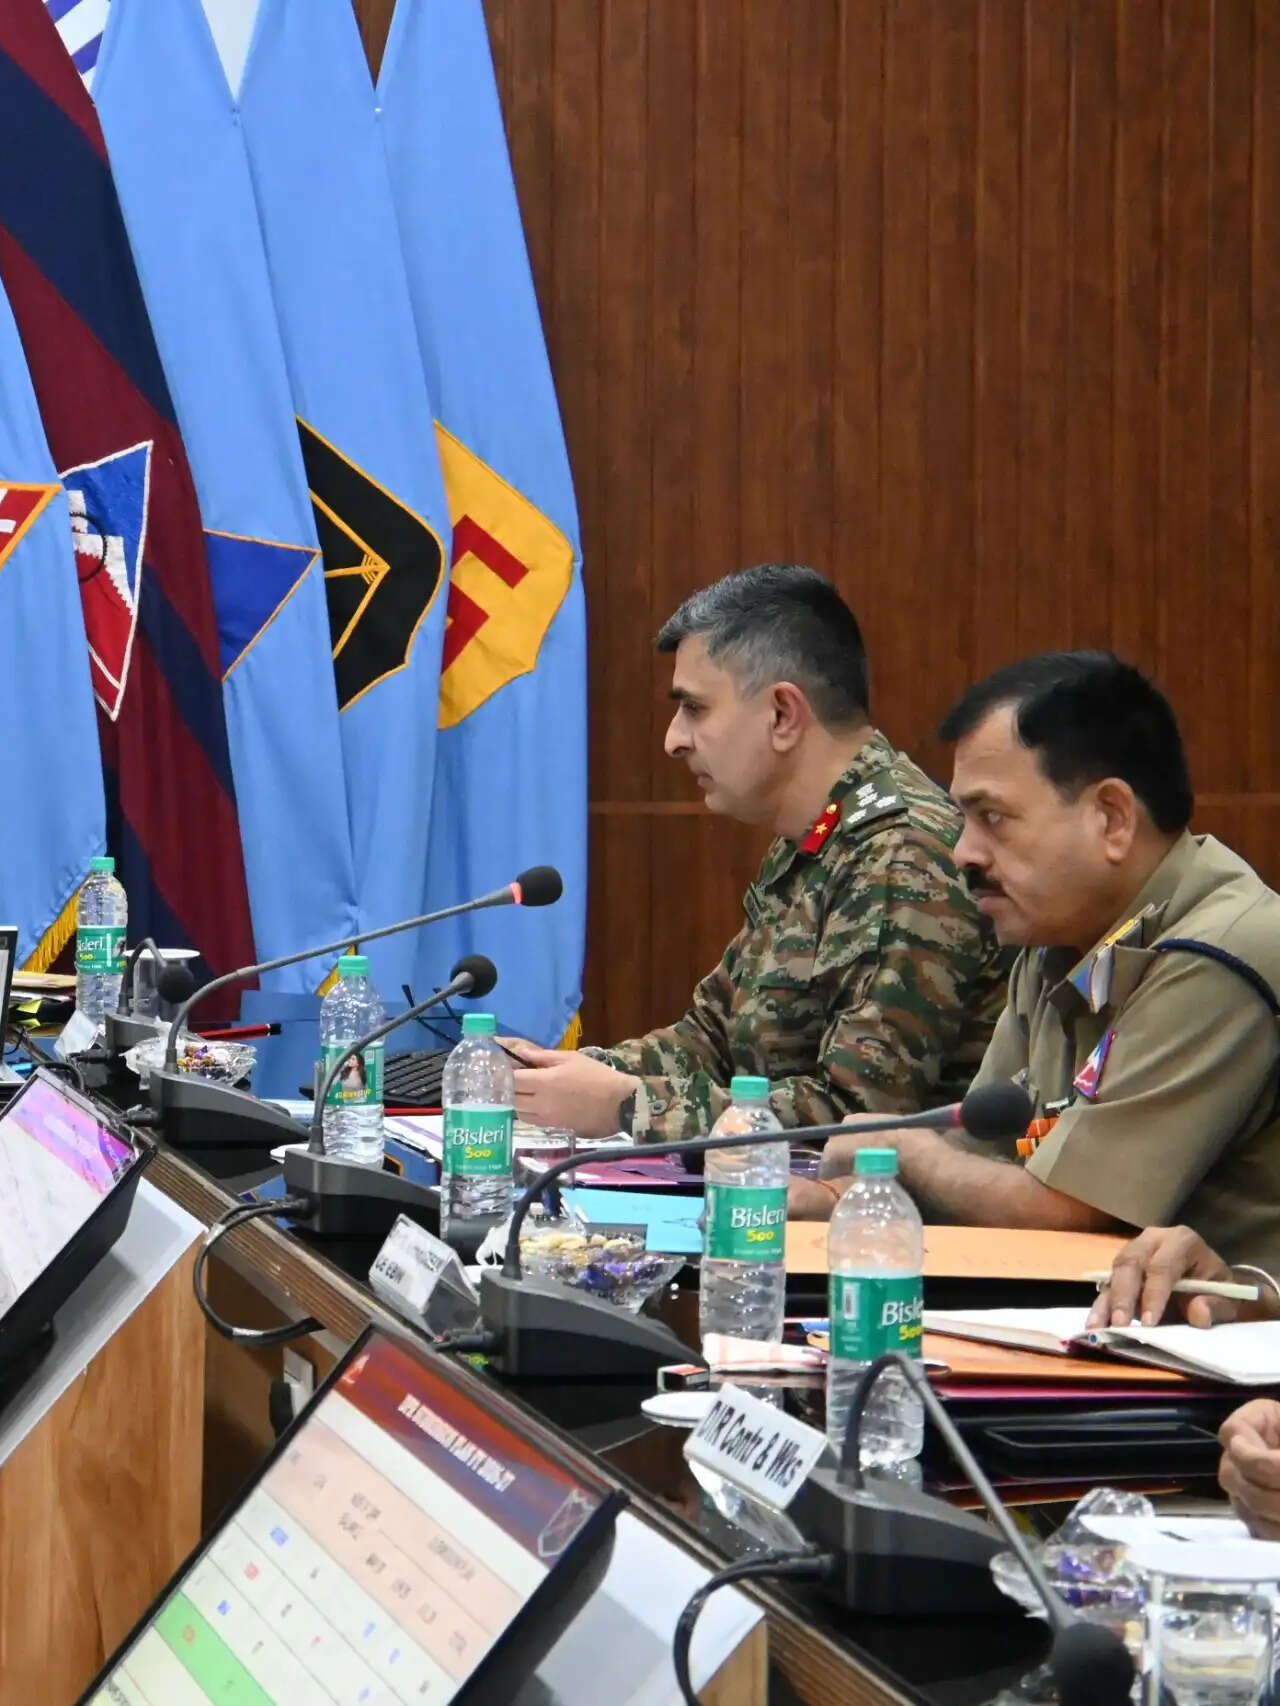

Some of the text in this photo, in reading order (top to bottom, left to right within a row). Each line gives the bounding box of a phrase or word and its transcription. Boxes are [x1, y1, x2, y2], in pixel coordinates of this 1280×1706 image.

[452, 1124, 504, 1146] Bisleri
[464, 1144, 493, 1159] 500
[746, 1228, 776, 1243] 500
[697, 1399, 736, 1448] DIR
[720, 1412, 764, 1466] Contr
[751, 1431, 781, 1471] &
